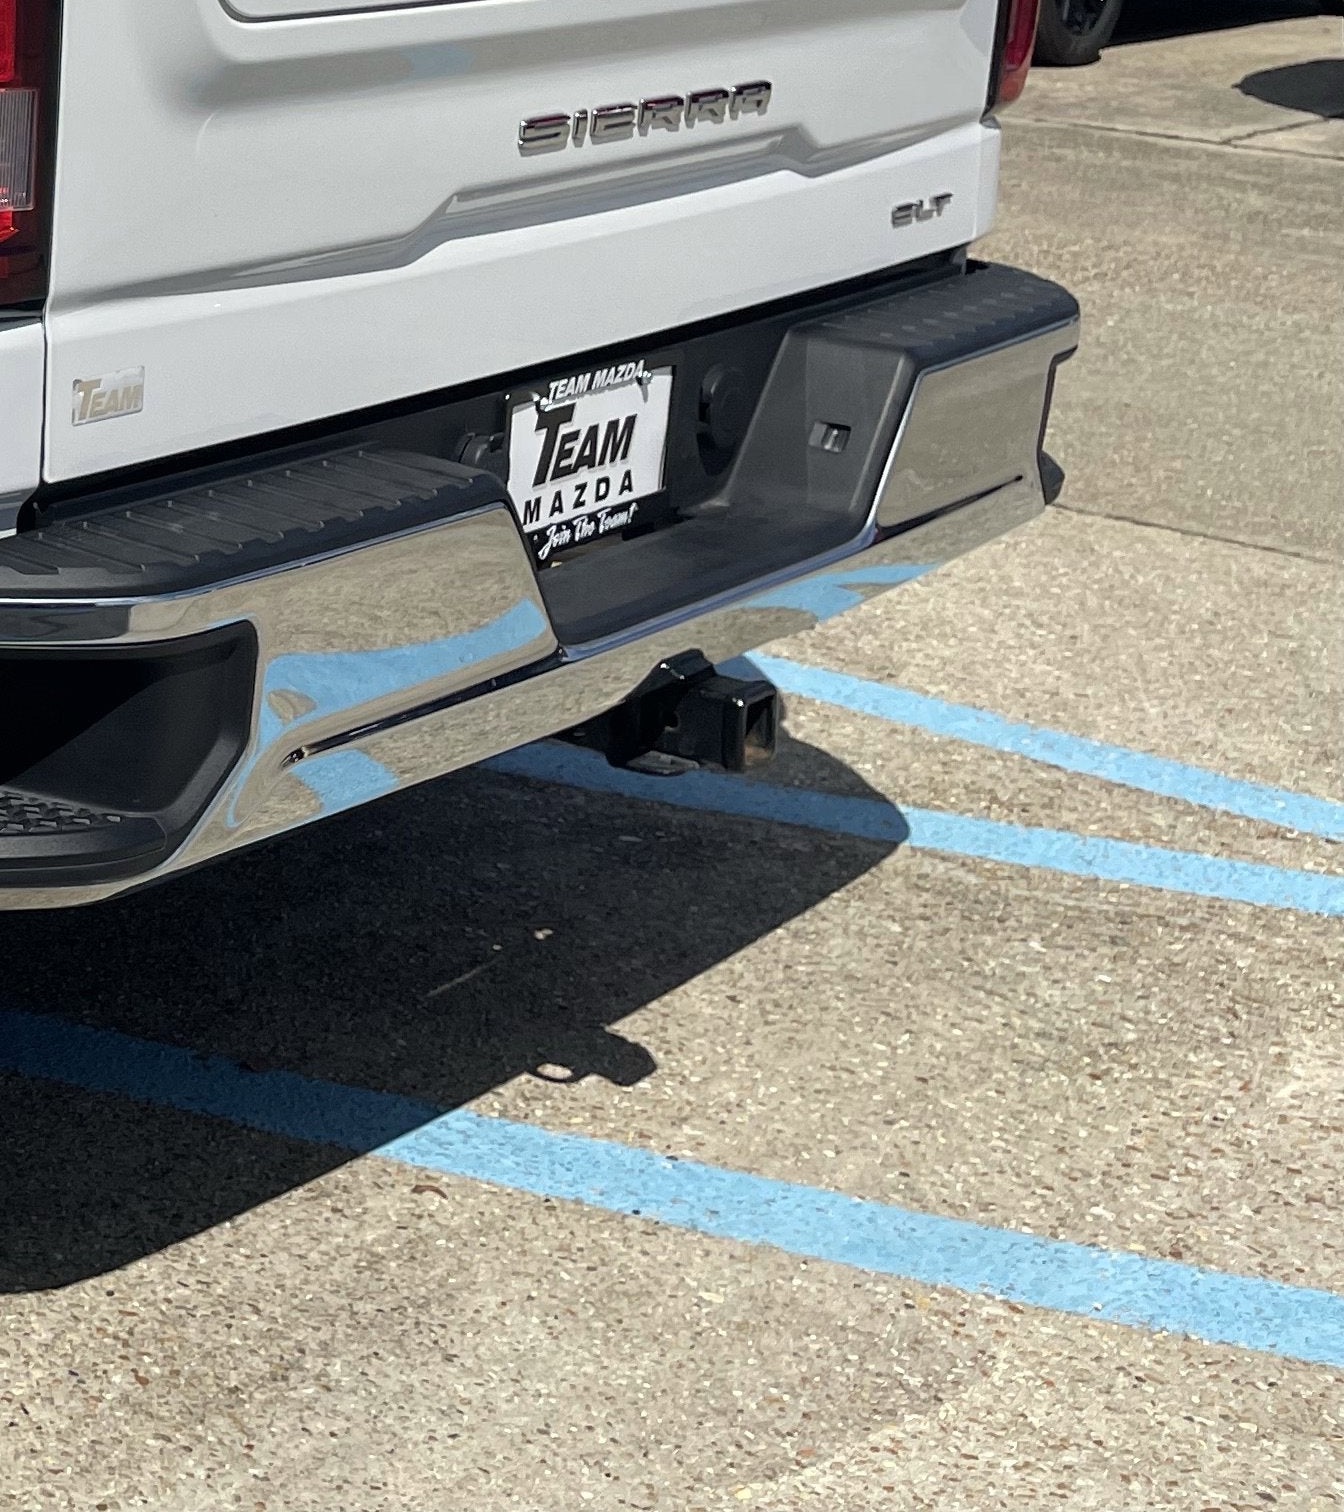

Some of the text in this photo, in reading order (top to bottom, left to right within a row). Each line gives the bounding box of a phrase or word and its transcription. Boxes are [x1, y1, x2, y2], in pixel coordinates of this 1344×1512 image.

[518, 80, 772, 156] SIERRA
[891, 193, 953, 229] SLT
[77, 379, 143, 421] TEAM
[548, 359, 645, 405] TEAM MAZDA
[532, 402, 637, 488] TEAM
[523, 469, 633, 526] MAZDA
[538, 525, 571, 560] Join
